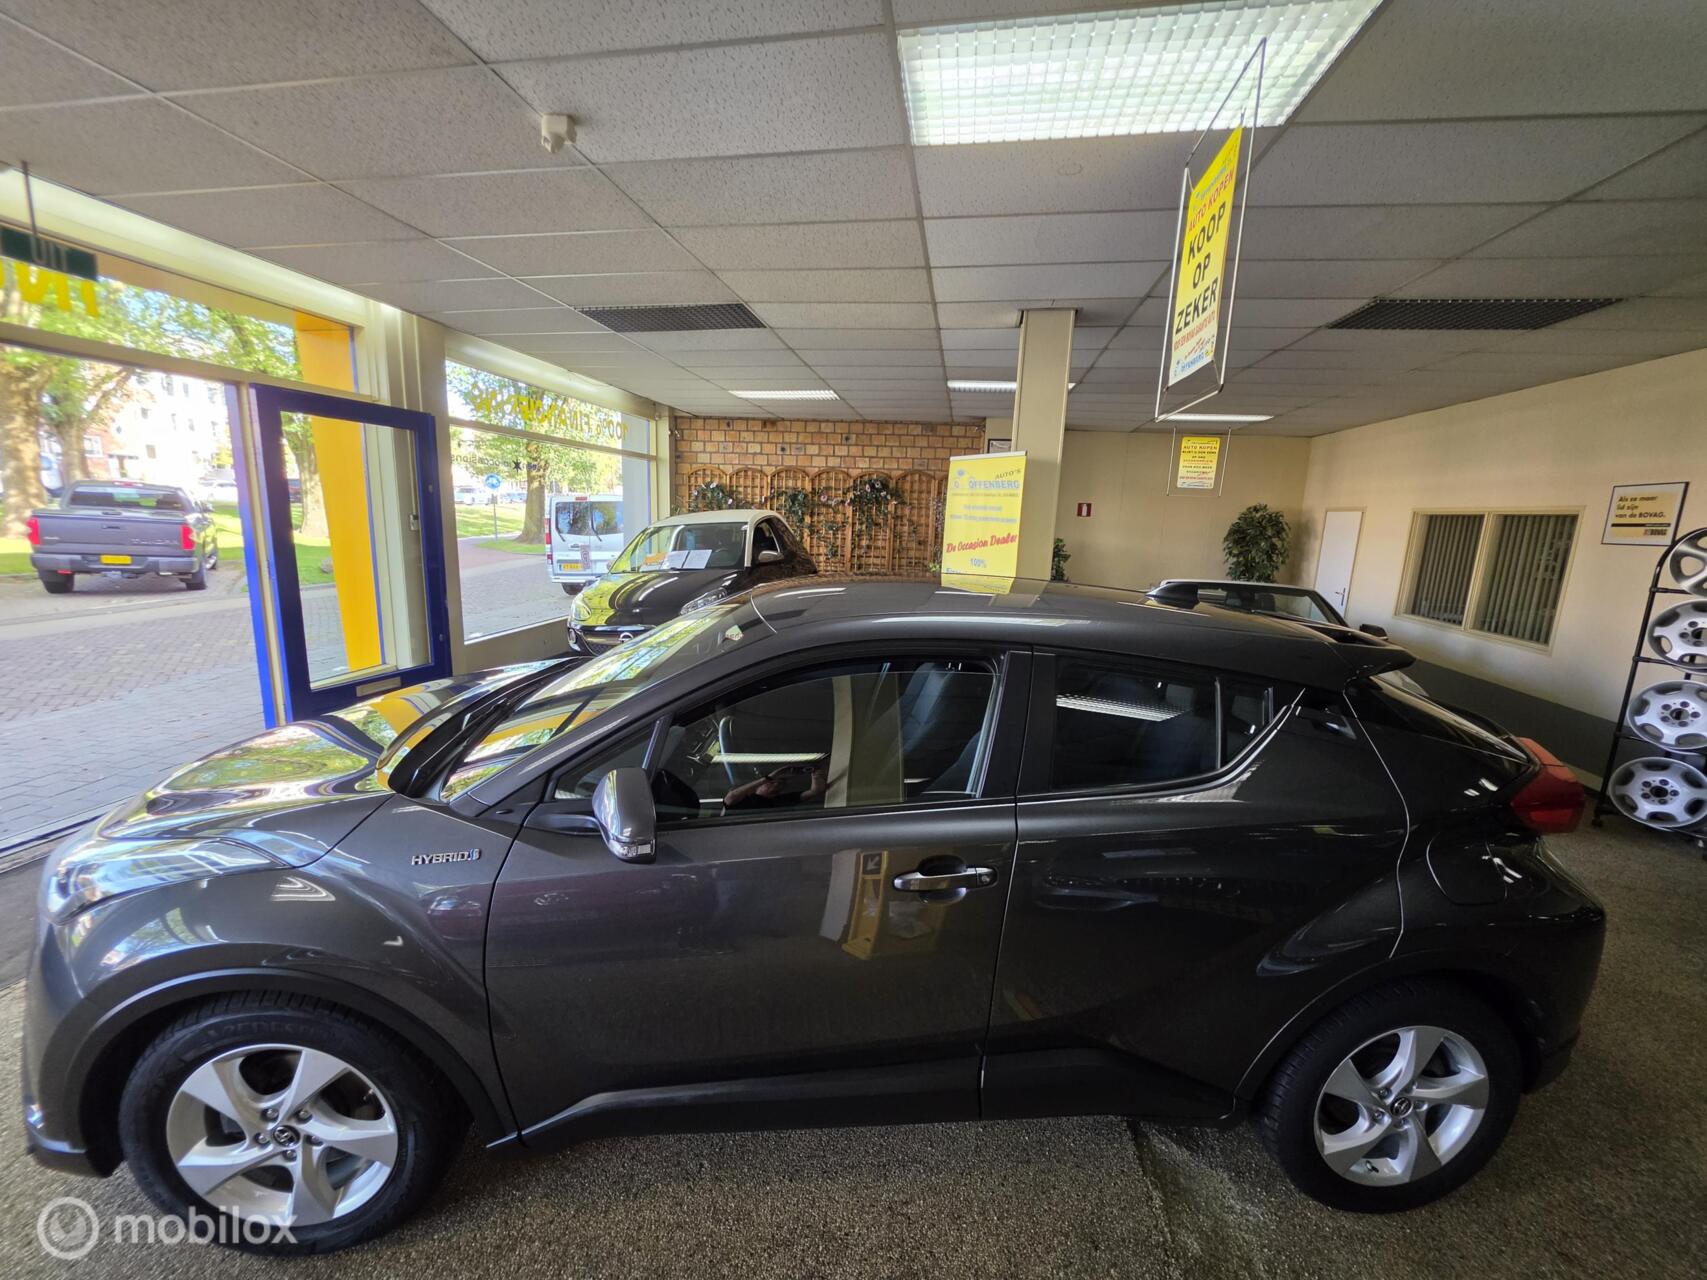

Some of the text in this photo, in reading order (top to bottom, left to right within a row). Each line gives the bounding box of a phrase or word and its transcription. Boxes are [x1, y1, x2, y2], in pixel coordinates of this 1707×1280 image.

[1187, 202, 1226, 264] KOOP
[1192, 252, 1211, 289] OP
[1175, 276, 1218, 335] ZEKER
[968, 480, 1020, 489] OFFENBERG
[957, 538, 988, 551] Occasion
[411, 851, 469, 865] HYBRID
